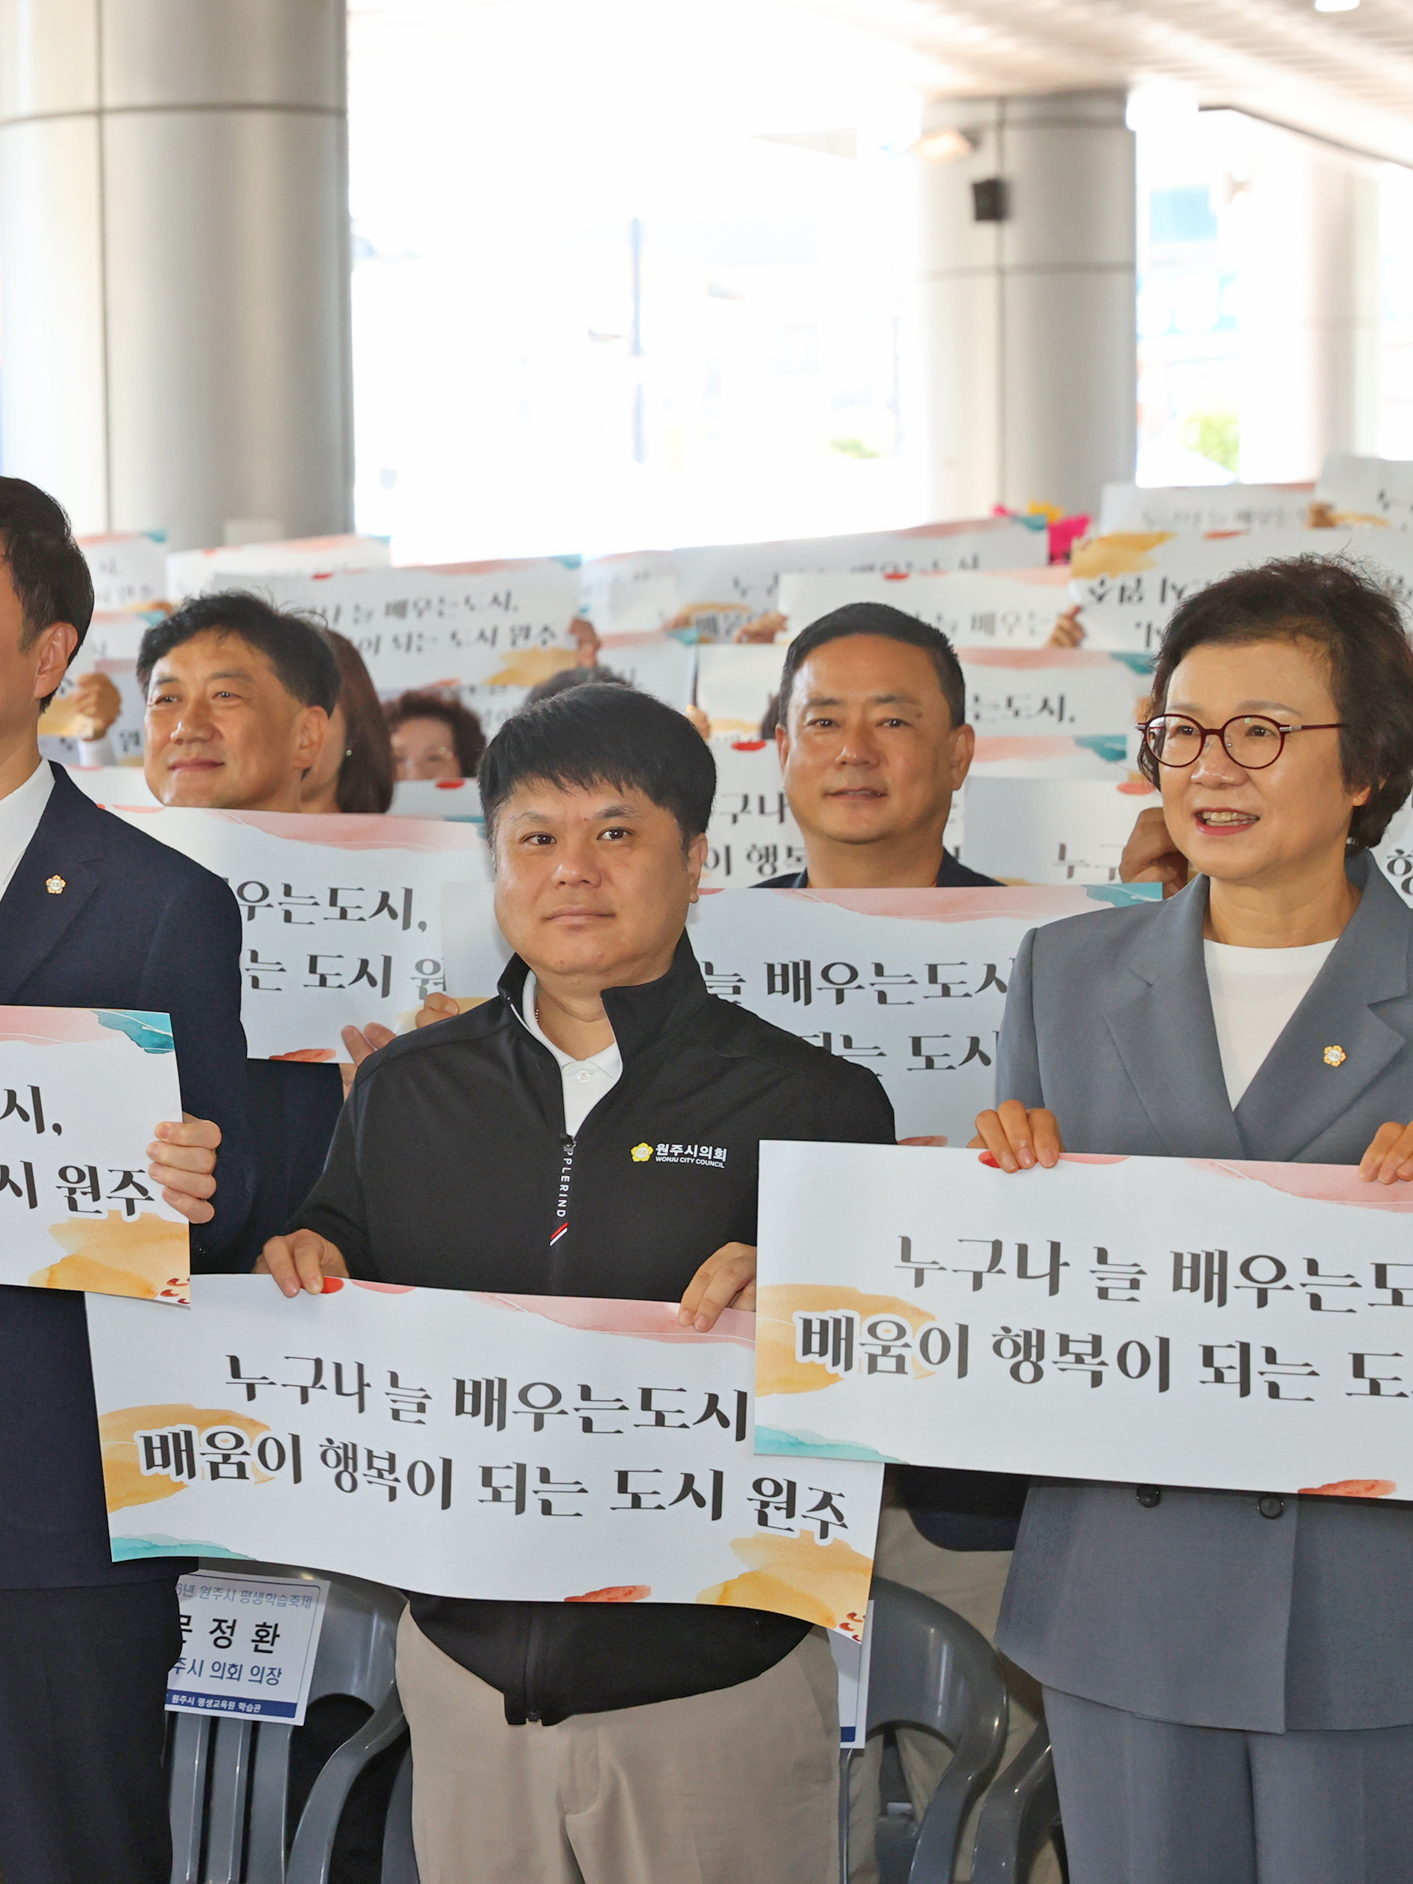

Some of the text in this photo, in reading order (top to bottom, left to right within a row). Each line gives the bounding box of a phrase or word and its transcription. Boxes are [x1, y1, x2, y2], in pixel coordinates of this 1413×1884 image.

[222, 875, 426, 933] 우는도시,
[303, 954, 392, 998] 도시
[655, 1143, 727, 1162] 원주시의회
[696, 1158, 725, 1168] COUNCIL
[56, 1163, 156, 1216] 원주
[895, 1236, 1070, 1296] 누구나
[1090, 1247, 1147, 1302] 늘
[799, 1316, 968, 1379] 배움이
[992, 1326, 1170, 1393] 행복이
[1199, 1341, 1320, 1401] 되는
[226, 1355, 747, 1442] 누구나 늘 배우는도시
[138, 1430, 848, 1539] 배움이 행복이 되는 도시 원주
[199, 1585, 237, 1603] 원주시
[240, 1589, 314, 1609] 평생학습축제
[209, 1660, 244, 1682] 의회
[248, 1665, 283, 1686] 의장
[171, 1693, 195, 1705] 원주시
